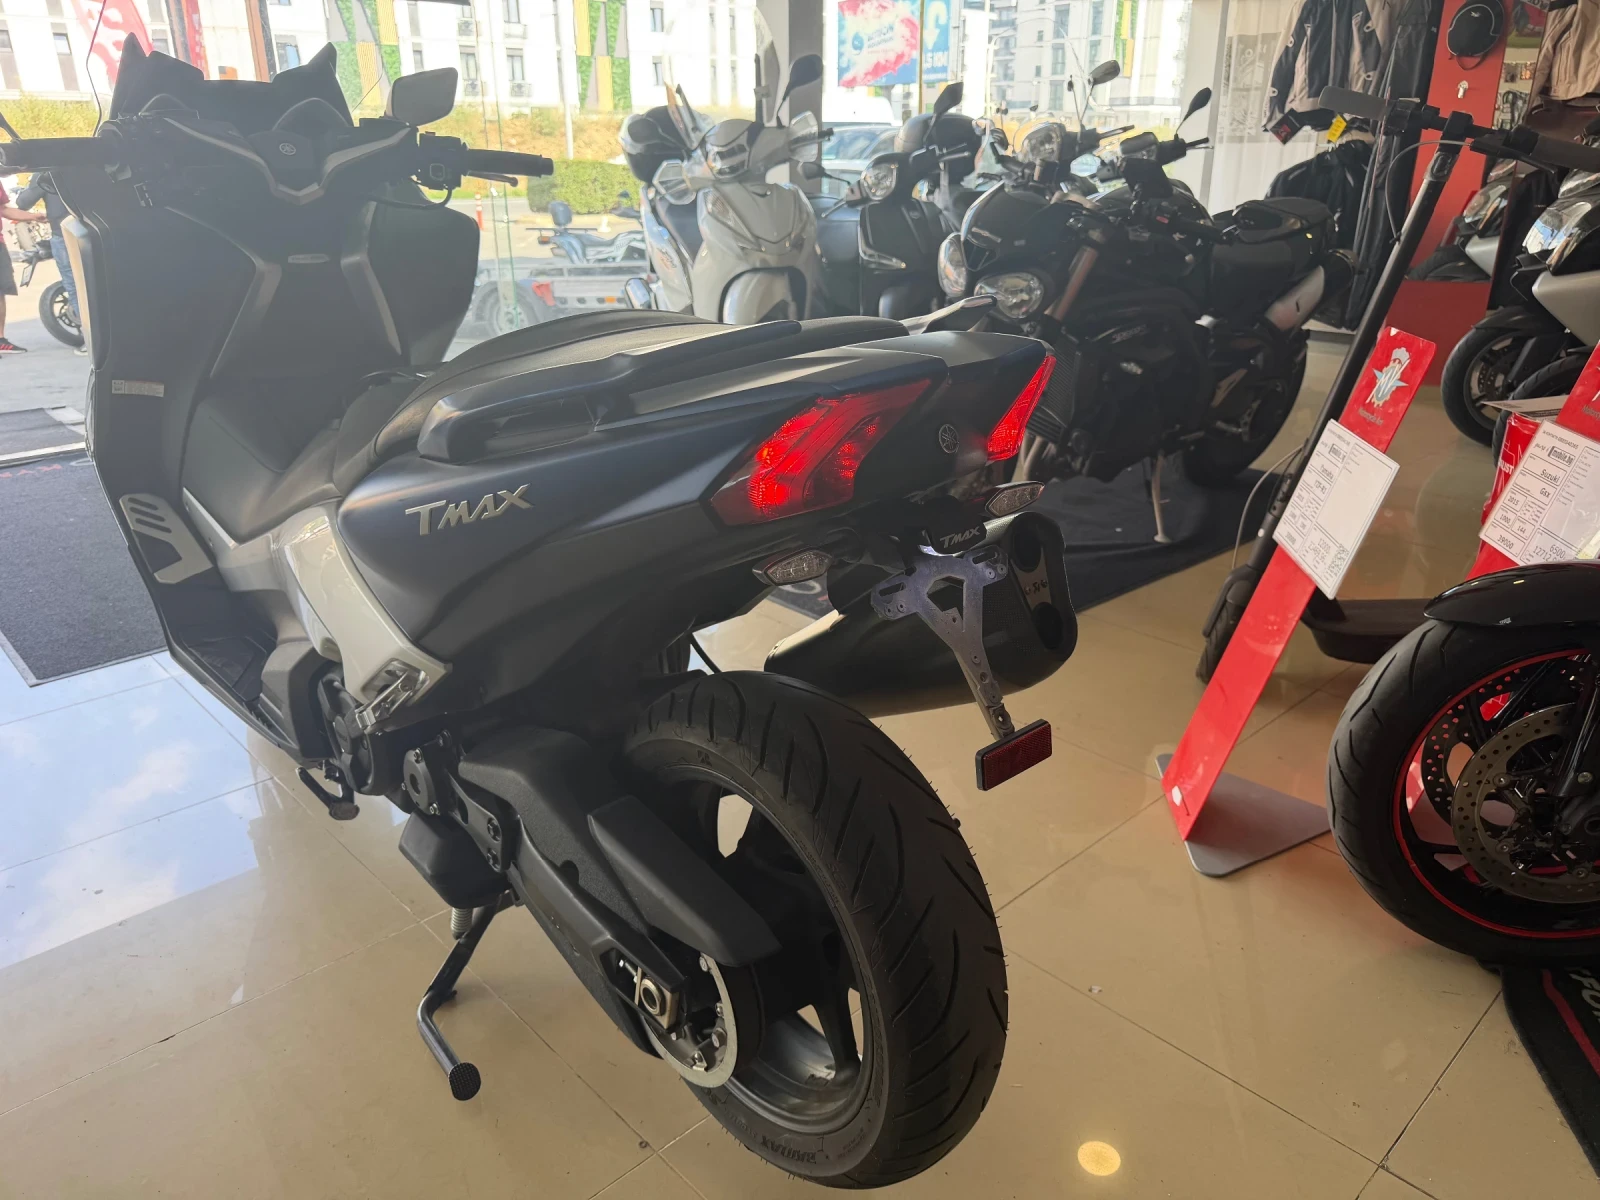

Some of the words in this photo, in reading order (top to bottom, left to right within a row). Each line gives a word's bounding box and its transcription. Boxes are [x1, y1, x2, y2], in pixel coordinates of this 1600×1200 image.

[1541, 468, 1561, 484] Suzuki
[1507, 495, 1520, 506] 2015
[1540, 487, 1551, 499] Gsx
[405, 483, 535, 536] TMAX
[1499, 513, 1511, 525] 1000
[940, 526, 980, 549] TMAX
[1517, 525, 1527, 535] 144
[1497, 534, 1514, 550] 39000
[761, 1133, 817, 1165] BATTLAX
